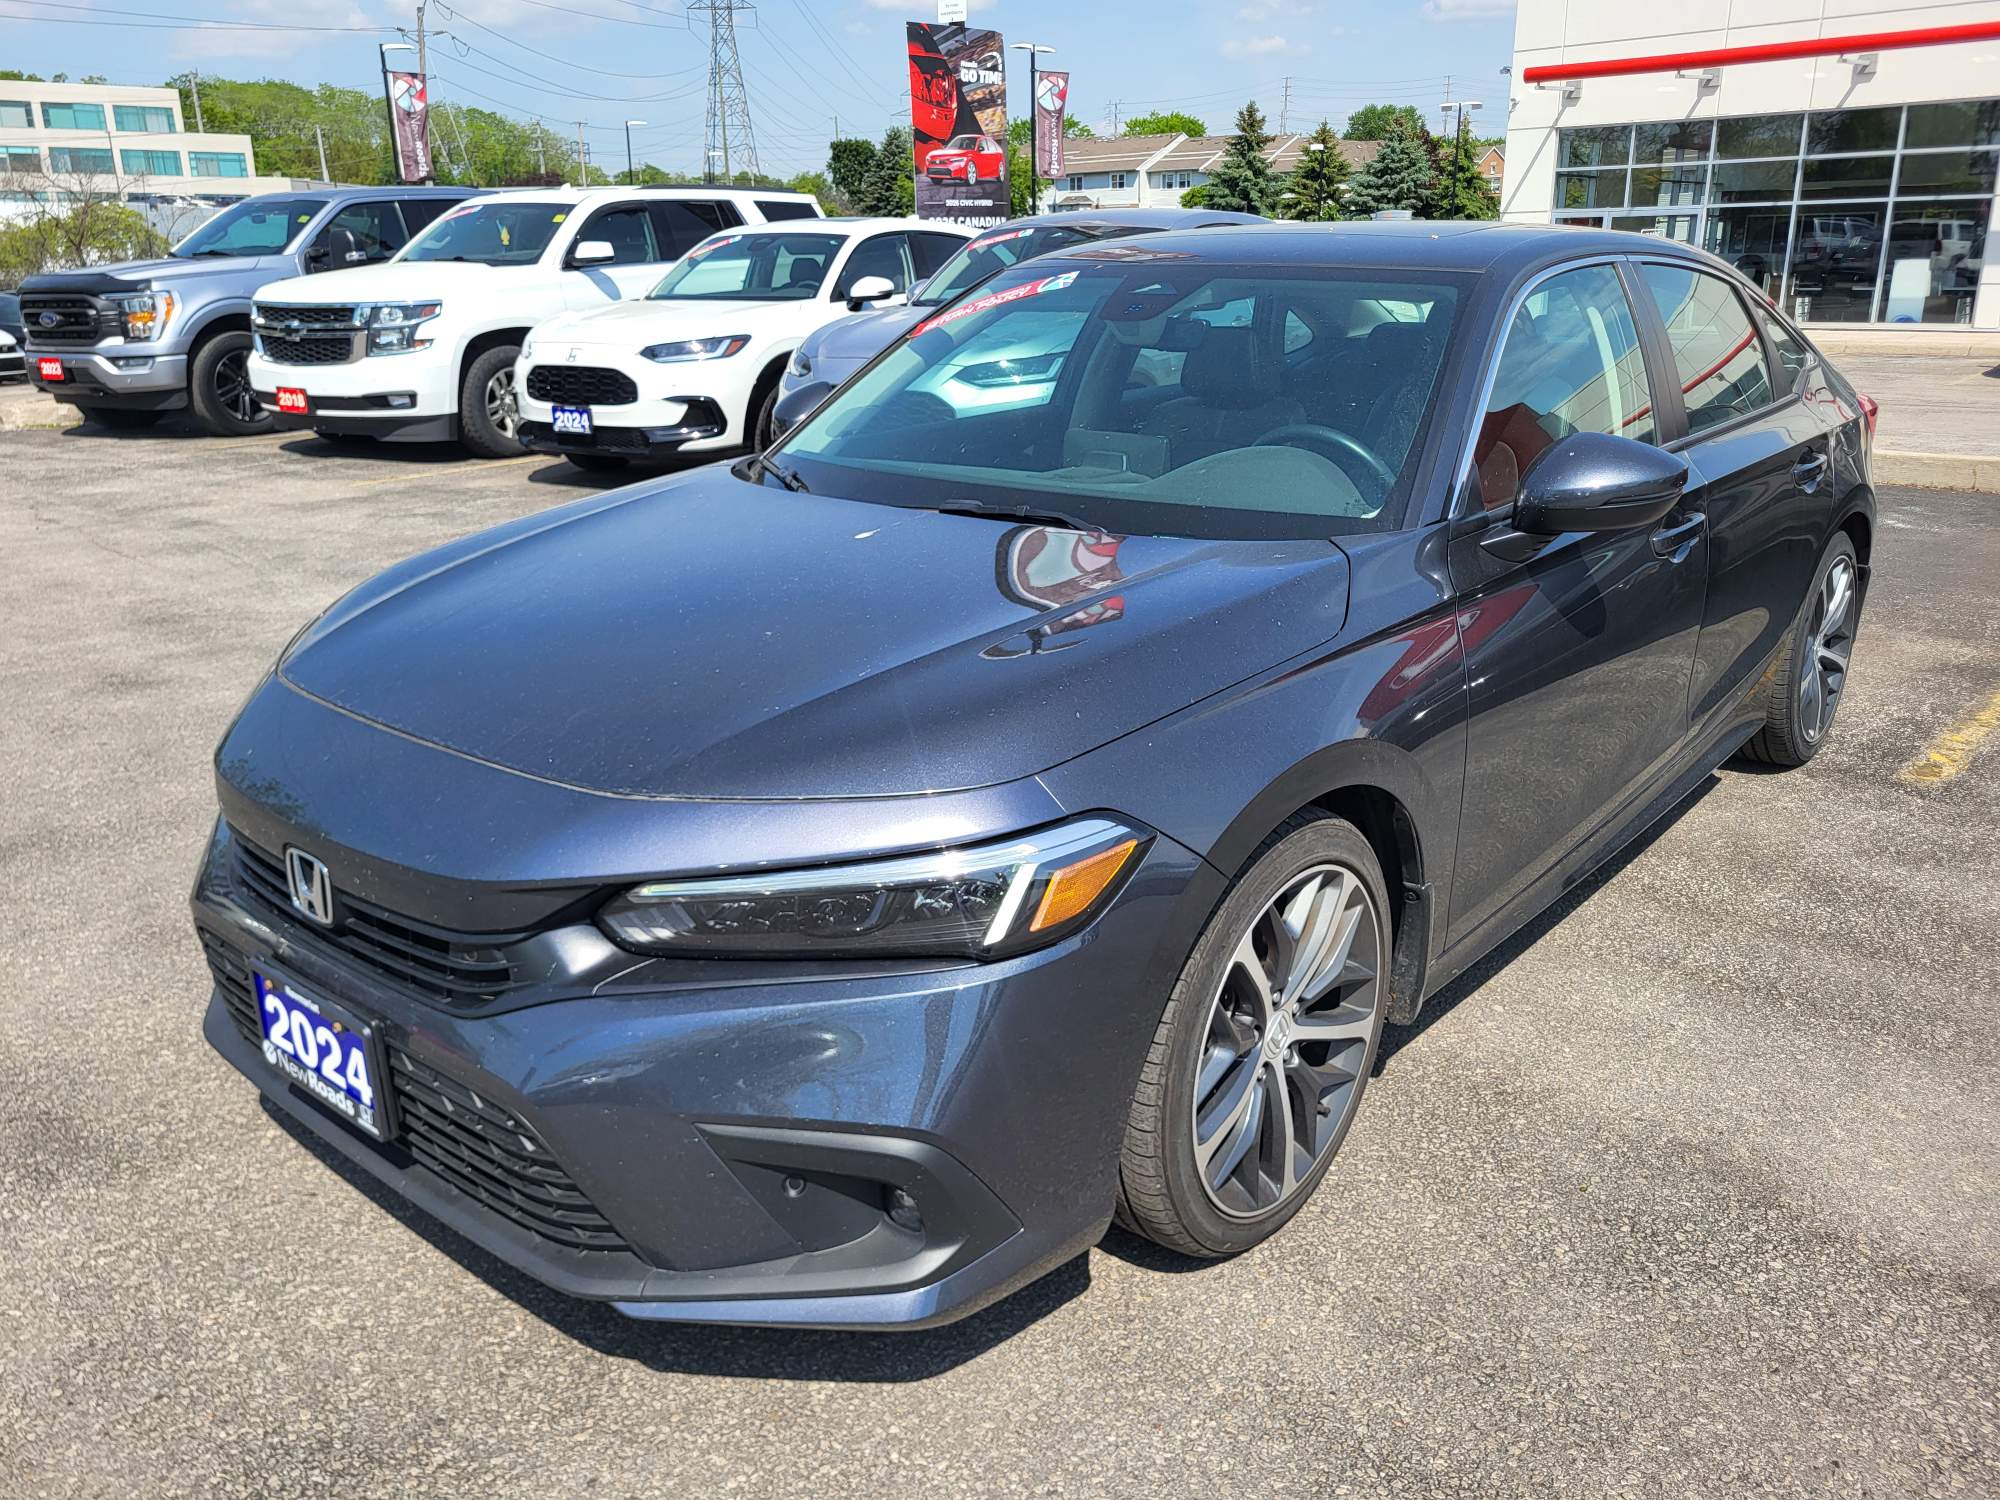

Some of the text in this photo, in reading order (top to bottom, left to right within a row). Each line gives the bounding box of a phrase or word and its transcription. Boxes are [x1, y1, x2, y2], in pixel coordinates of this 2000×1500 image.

[960, 69, 978, 83] GO
[1050, 112, 1060, 175] NewRoads
[960, 199, 974, 207] CIVIC
[974, 199, 993, 207] HYBRID
[278, 392, 306, 407] 2018
[554, 411, 590, 430] 2024
[264, 993, 374, 1107] 2024
[277, 1052, 355, 1117] NewRoads
